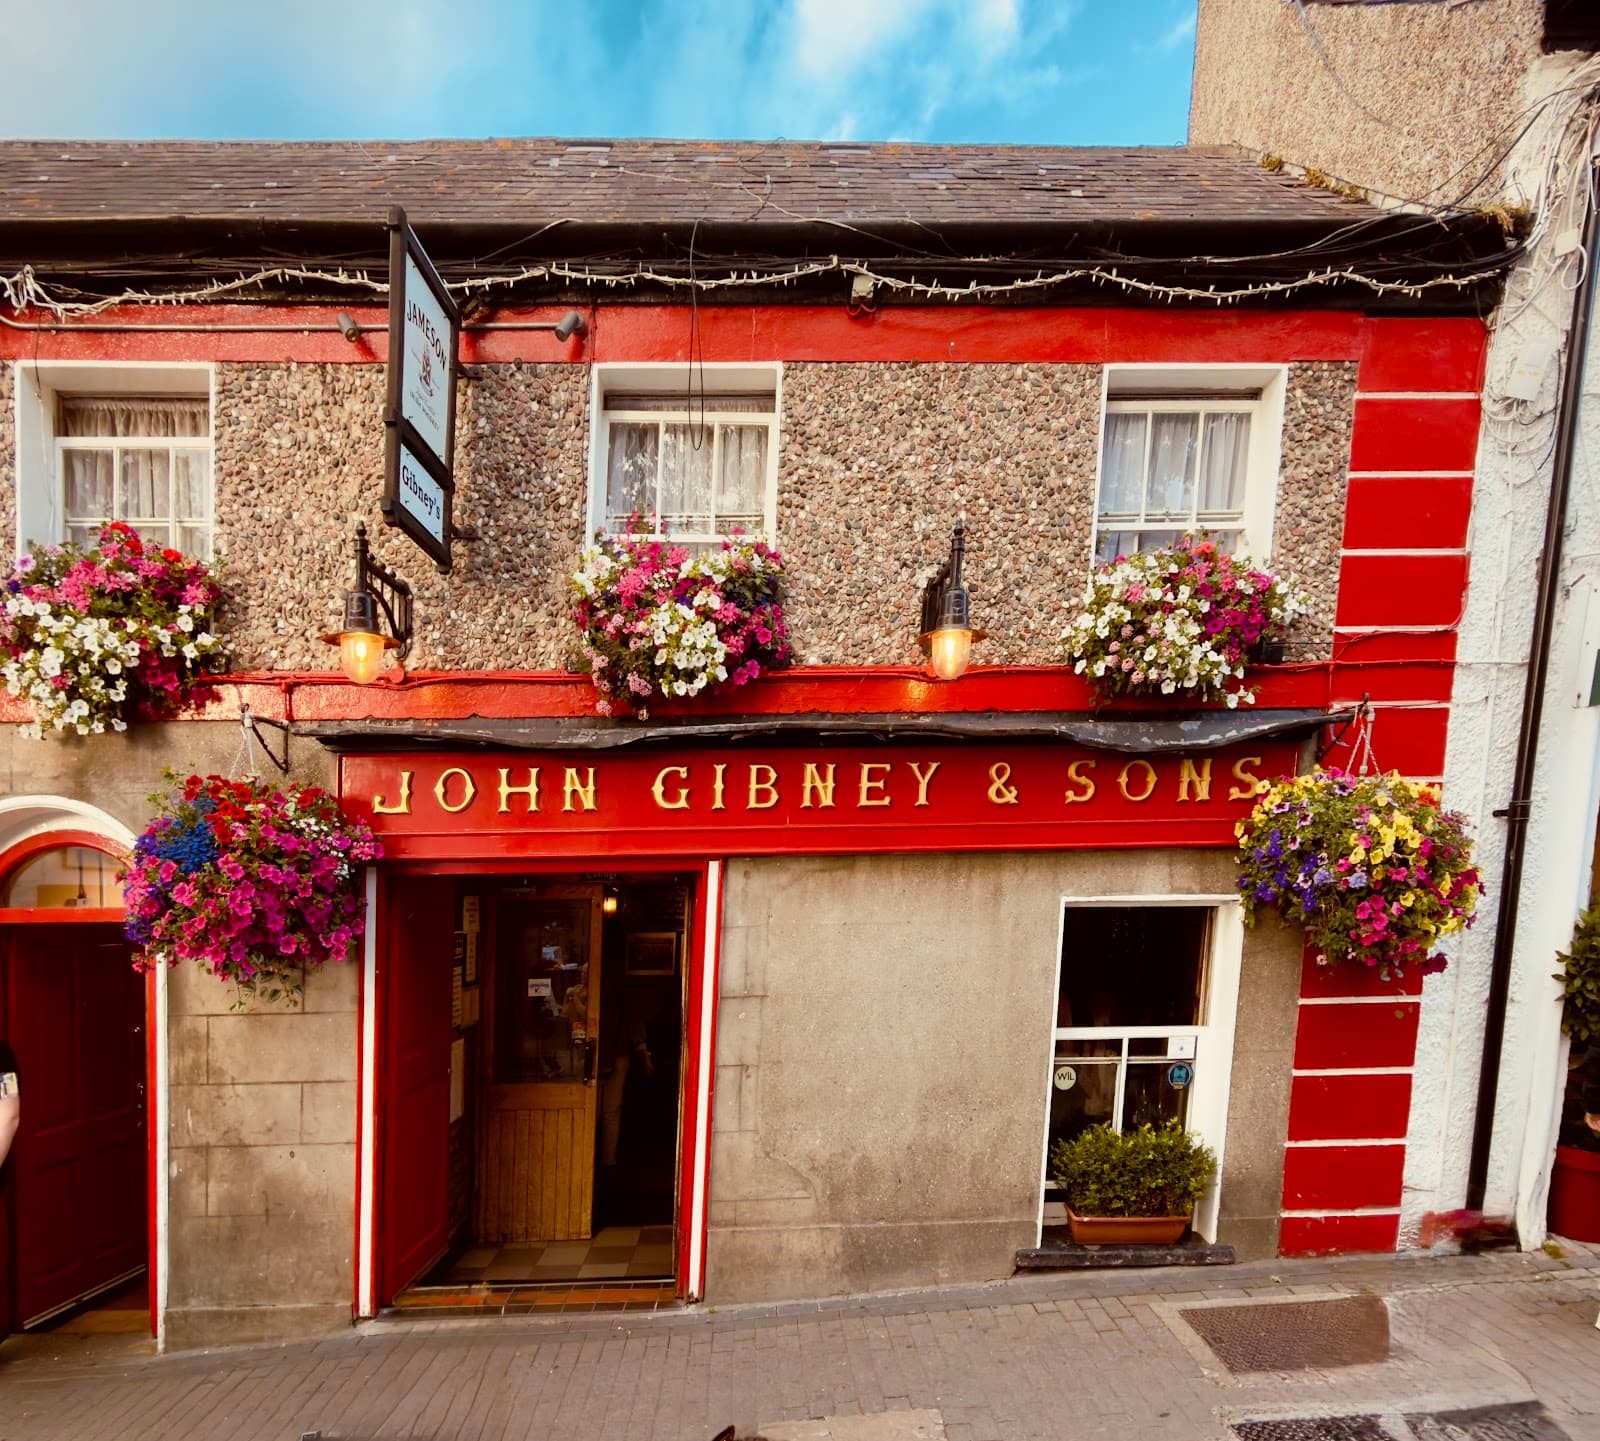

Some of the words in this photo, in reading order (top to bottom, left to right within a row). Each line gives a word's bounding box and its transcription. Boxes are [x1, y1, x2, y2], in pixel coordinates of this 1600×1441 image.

[406, 299, 447, 372] JAMESON
[402, 464, 441, 520] Gibney's
[372, 766, 598, 815] JOHN
[651, 761, 941, 810] GIBNEY
[987, 761, 1019, 804] &
[1065, 756, 1263, 804] SONS
